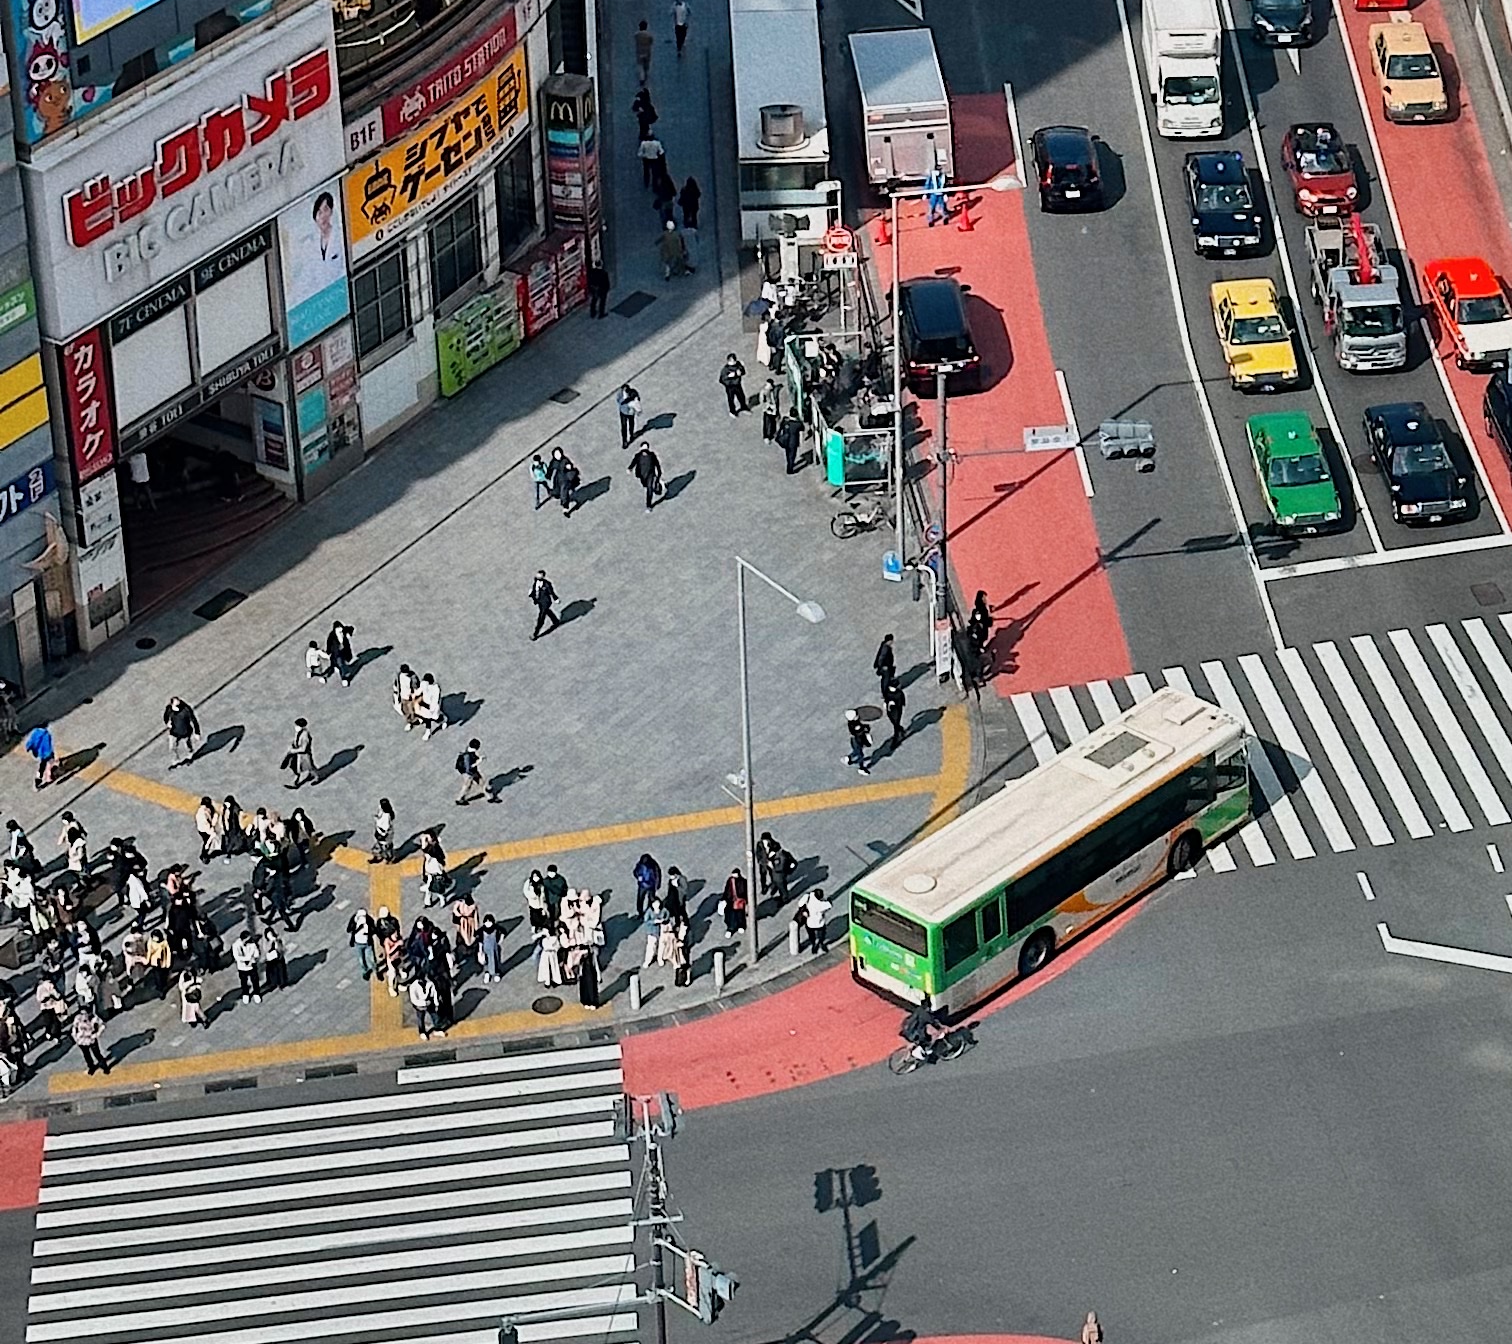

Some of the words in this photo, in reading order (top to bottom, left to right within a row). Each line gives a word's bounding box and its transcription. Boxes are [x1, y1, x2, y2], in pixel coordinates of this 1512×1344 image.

[427, 67, 463, 106] TAITO
[463, 25, 508, 77] STATION
[64, 48, 334, 250] ビックカメラ
[350, 120, 377, 152] B1F
[164, 137, 306, 244] CAMERA
[218, 234, 267, 274] CINEMA
[135, 283, 187, 324] CINEMA
[73, 342, 105, 460] カラオケ
[208, 364, 253, 396] SHIBUYA
